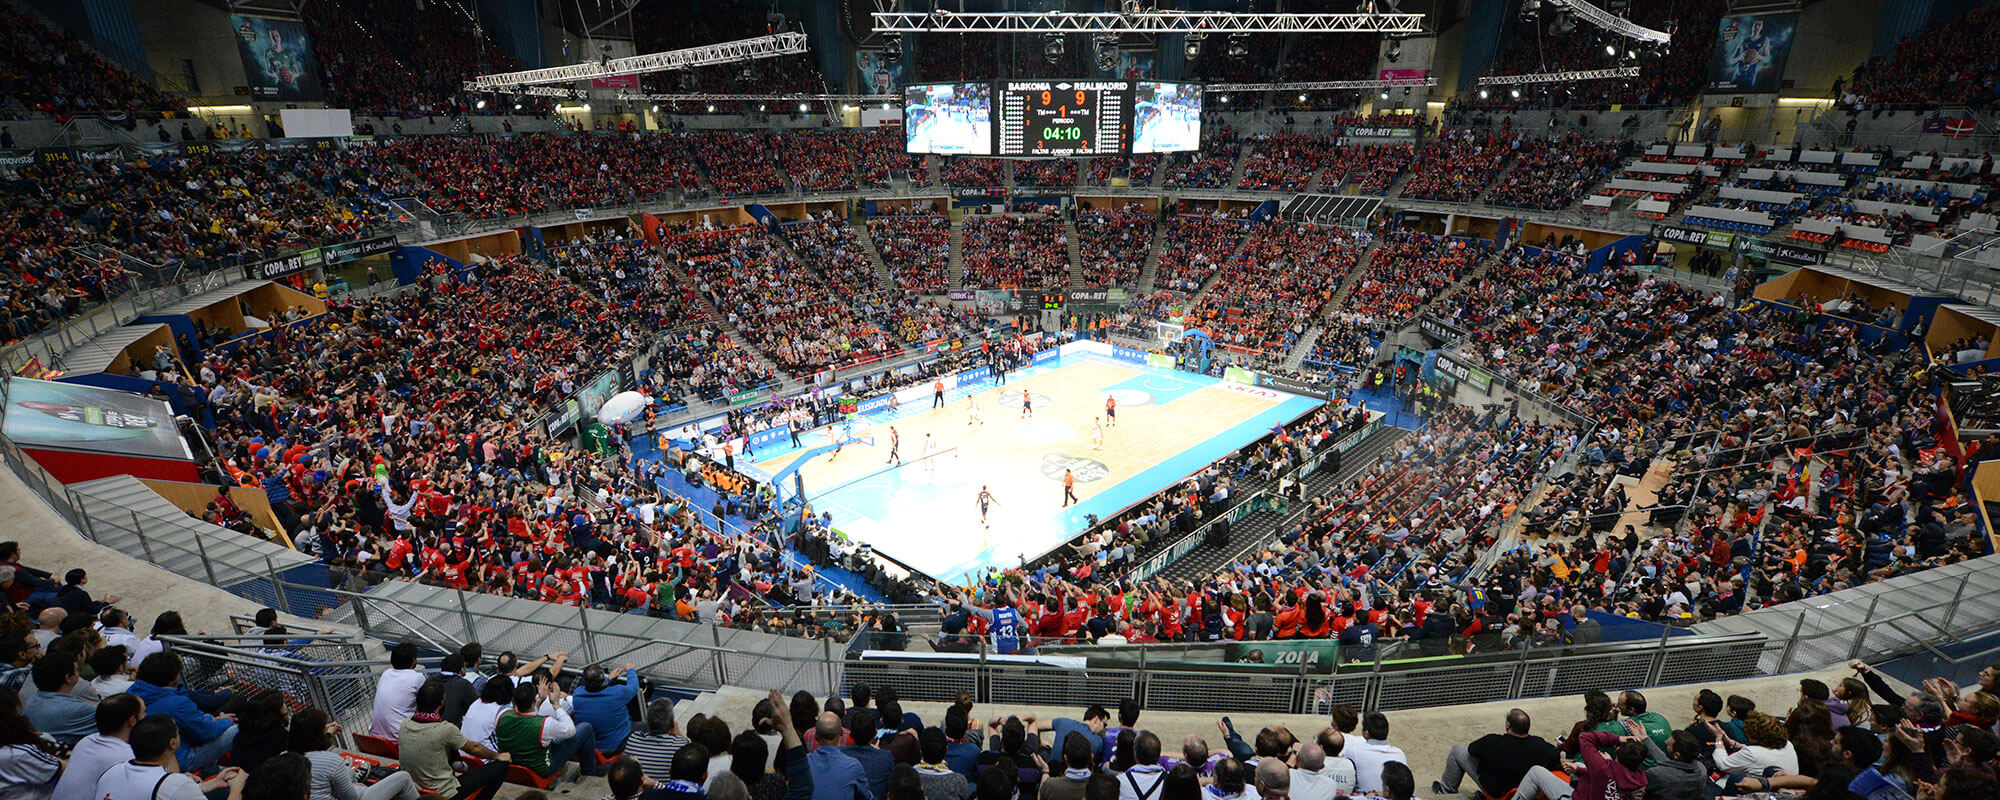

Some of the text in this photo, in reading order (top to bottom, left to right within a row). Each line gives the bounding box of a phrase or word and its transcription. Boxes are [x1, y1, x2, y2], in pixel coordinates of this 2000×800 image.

[1008, 82, 1051, 91] BASKONIA
[1041, 90, 1051, 106] 9
[1075, 90, 1085, 106] 9
[1059, 105, 1066, 118] 1
[1043, 126, 1081, 140] 04:10
[1355, 127, 1373, 136] COPA
[1377, 127, 1392, 136] REY
[187, 145, 210, 154] 311-B
[317, 141, 330, 149] 312
[1037, 140, 1044, 149] 3
[1081, 140, 1088, 149] 2
[0, 156, 35, 165] movistar
[45, 151, 69, 162] 311-A
[962, 188, 977, 196] COPA
[1663, 227, 1686, 240] COPA
[1689, 231, 1708, 244] REY
[337, 246, 361, 257] movistar
[1750, 244, 1776, 254] movistar
[1788, 250, 1817, 263] CaixaBank
[264, 259, 285, 276] COPA
[288, 255, 303, 271] REY
[1071, 292, 1107, 300] COPA REY
[1437, 356, 1454, 372] COPA
[1455, 365, 1470, 380] REY
[857, 396, 891, 413] EUSKADI
[1150, 550, 1170, 575] REY
[1475, 590, 1484, 600] 11
[1000, 625, 1014, 638] 13
